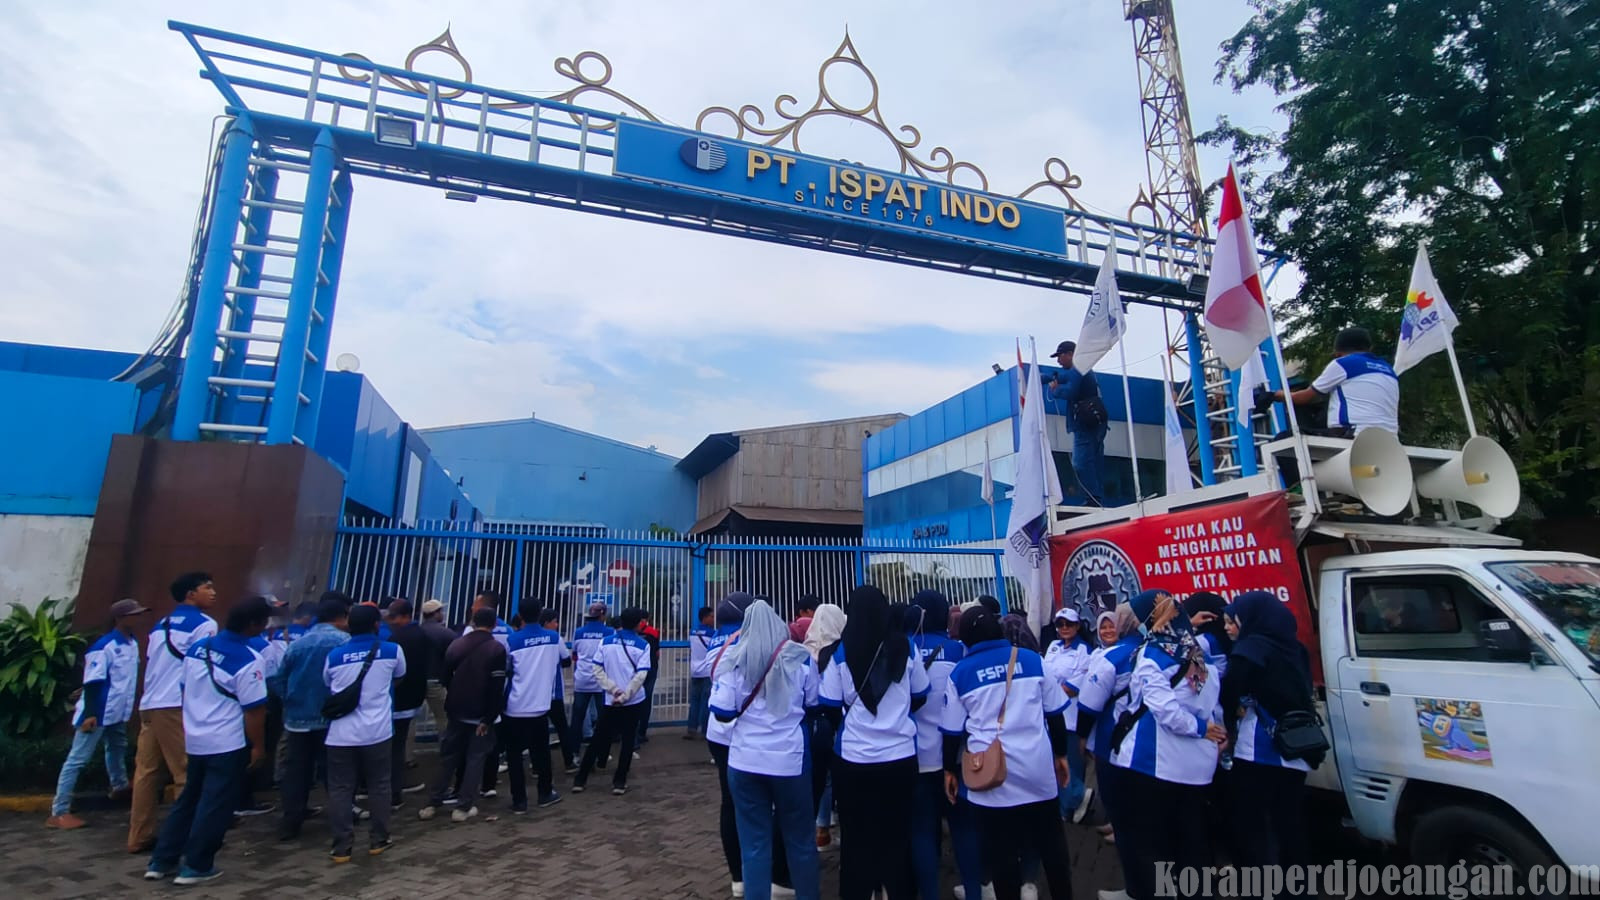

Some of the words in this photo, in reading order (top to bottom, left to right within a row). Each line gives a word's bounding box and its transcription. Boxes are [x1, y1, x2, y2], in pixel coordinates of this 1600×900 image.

[747, 150, 796, 185] PT
[829, 166, 928, 211] ISPAT
[940, 189, 1020, 230] INDO
[794, 190, 870, 215] SINCE
[882, 206, 934, 227] 1976
[1211, 516, 1244, 535] KAU
[1158, 532, 1257, 559] MENGHAMBA
[1145, 560, 1182, 577] PADA
[1185, 548, 1282, 573] KETAKUTAN
[1192, 572, 1229, 589] KITA
